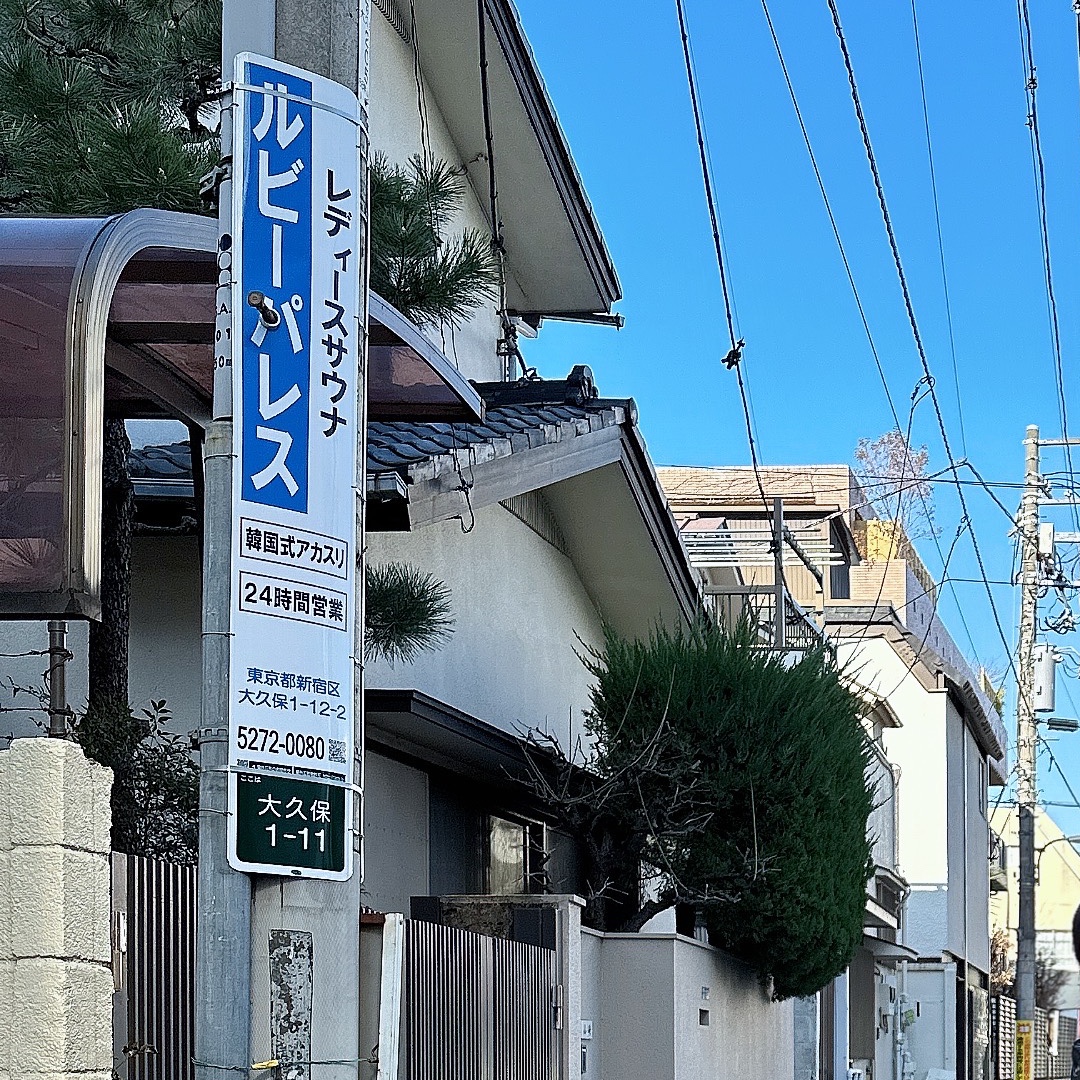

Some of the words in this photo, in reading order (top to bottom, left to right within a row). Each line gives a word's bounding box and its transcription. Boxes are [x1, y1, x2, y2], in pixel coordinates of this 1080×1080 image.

[252, 81, 305, 498] ルビーパレス
[320, 168, 352, 438] レディースサウナ
[245, 527, 345, 569] 韓国式アカスリ
[244, 582, 343, 622] 24時間営業
[246, 667, 340, 698] 東京都新宿区
[238, 688, 347, 720] 大久保1-12-2
[237, 725, 325, 760] 5272-0080
[258, 793, 331, 823] 大久保
[265, 823, 325, 852] 1-11
